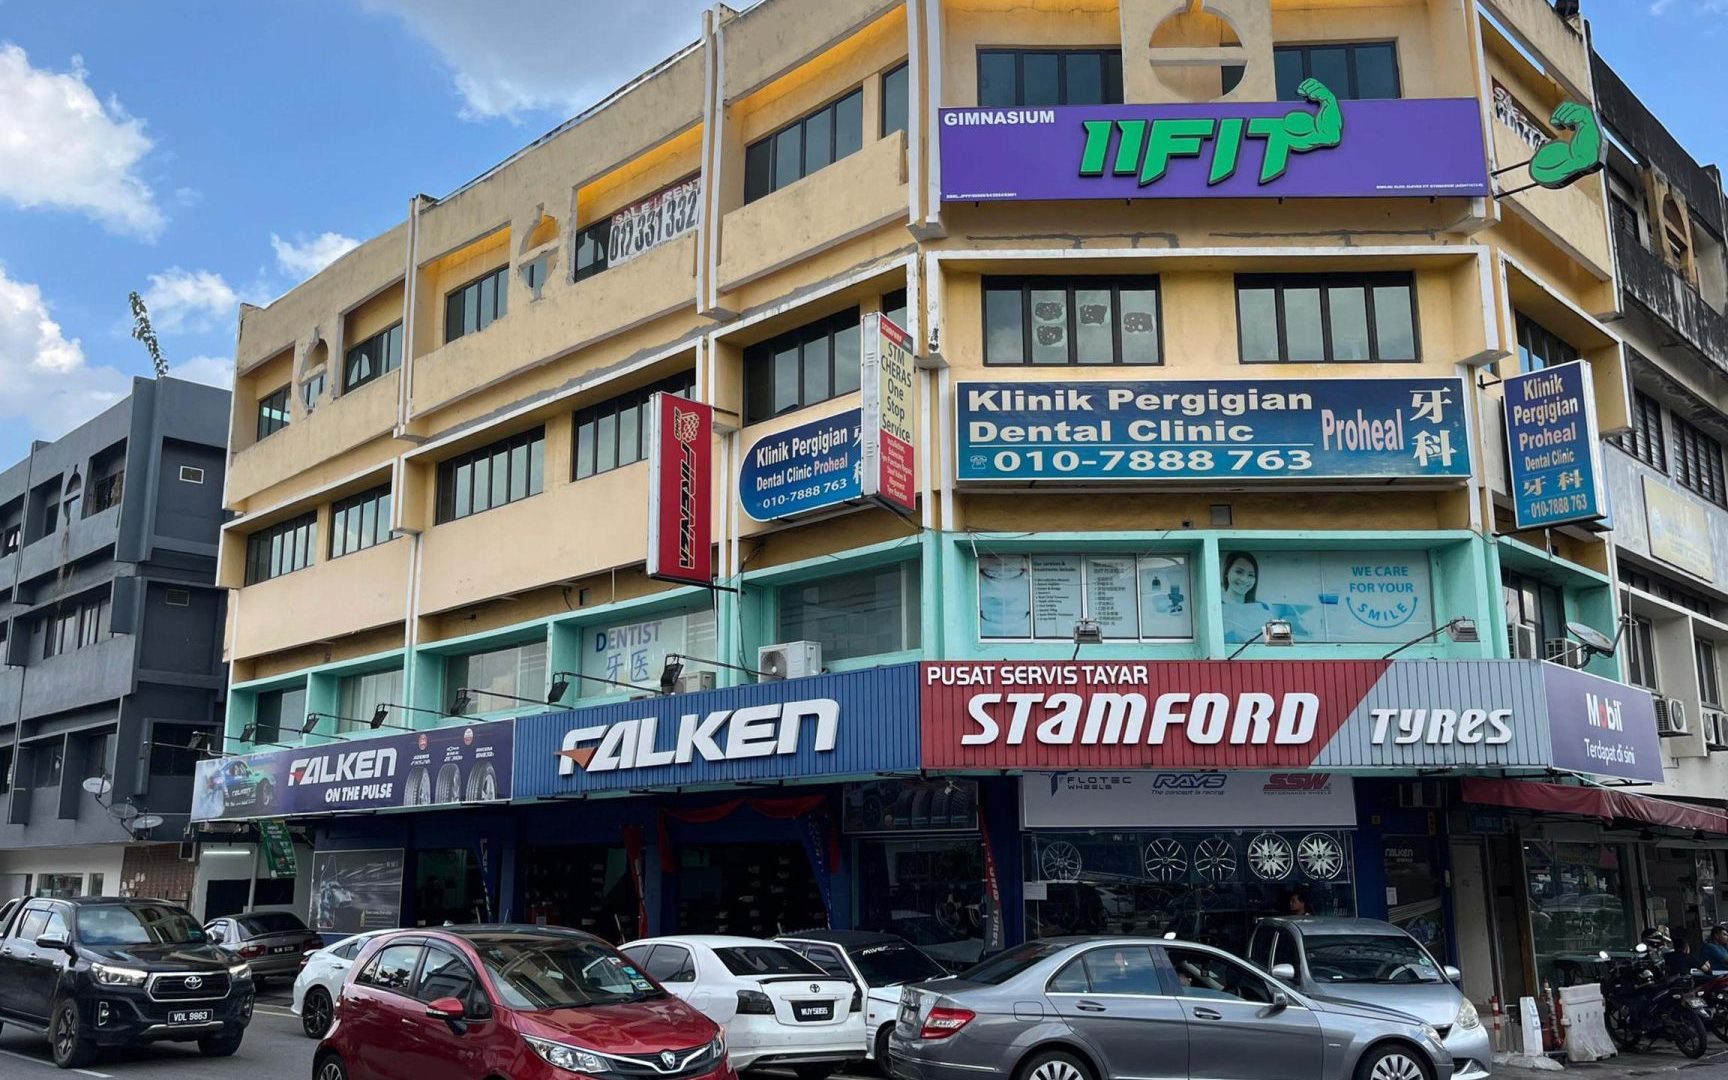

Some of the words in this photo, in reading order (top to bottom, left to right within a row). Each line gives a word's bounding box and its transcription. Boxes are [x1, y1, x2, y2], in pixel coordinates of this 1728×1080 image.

[944, 110, 1055, 127] GIMNASIUM
[614, 202, 650, 223] SALE
[888, 342, 905, 365] STM
[881, 355, 912, 388] CHERAS
[888, 380, 904, 401] One
[1523, 373, 1564, 401] Klinik
[886, 396, 906, 421] Stop
[968, 389, 1093, 412] Klinik
[1108, 389, 1312, 417] Pergigian
[1513, 397, 1579, 427] Pergigian
[882, 415, 911, 443] Service
[968, 420, 1112, 443] Dental
[1128, 420, 1255, 443] Clinic
[1320, 408, 1404, 452] Proheal
[1409, 386, 1457, 468] 牙科
[1519, 422, 1577, 451] Proheal
[756, 441, 789, 468] Klinik
[792, 427, 848, 459] Pergigian
[993, 449, 1215, 473] 010-7888
[1228, 449, 1313, 472] 763
[1525, 453, 1550, 471] Dental
[1551, 449, 1575, 467] Clinic
[756, 471, 785, 491] Dental
[787, 465, 812, 484] Clinic
[814, 453, 848, 475] Proheal
[679, 439, 697, 570] FIRENZA
[762, 486, 820, 509] 010-7888
[824, 478, 848, 494] 763
[1530, 495, 1570, 519] 010-7888
[1571, 493, 1588, 513] 763
[1351, 566, 1372, 577] WE
[1375, 565, 1409, 577] CARE
[1349, 582, 1376, 593] FOR
[1377, 582, 1414, 593] YOUR
[1358, 602, 1408, 622] SMILE
[595, 622, 663, 652] DENTIST
[927, 666, 996, 685] PUSAT
[1000, 666, 1078, 685] SERVIS
[1082, 666, 1149, 685] TAYAR
[1585, 692, 1623, 732] Mobil
[555, 698, 841, 776] FALKEN
[1584, 738, 1616, 766] Terdapat
[1616, 743, 1624, 764] di
[1624, 746, 1636, 765] sini
[288, 747, 398, 787] FALKEN
[1067, 776, 1132, 784] FLOTEC
[1153, 774, 1227, 788] RAYS
[325, 787, 341, 803] ON
[342, 785, 361, 801] THE
[361, 783, 393, 800] PULSE
